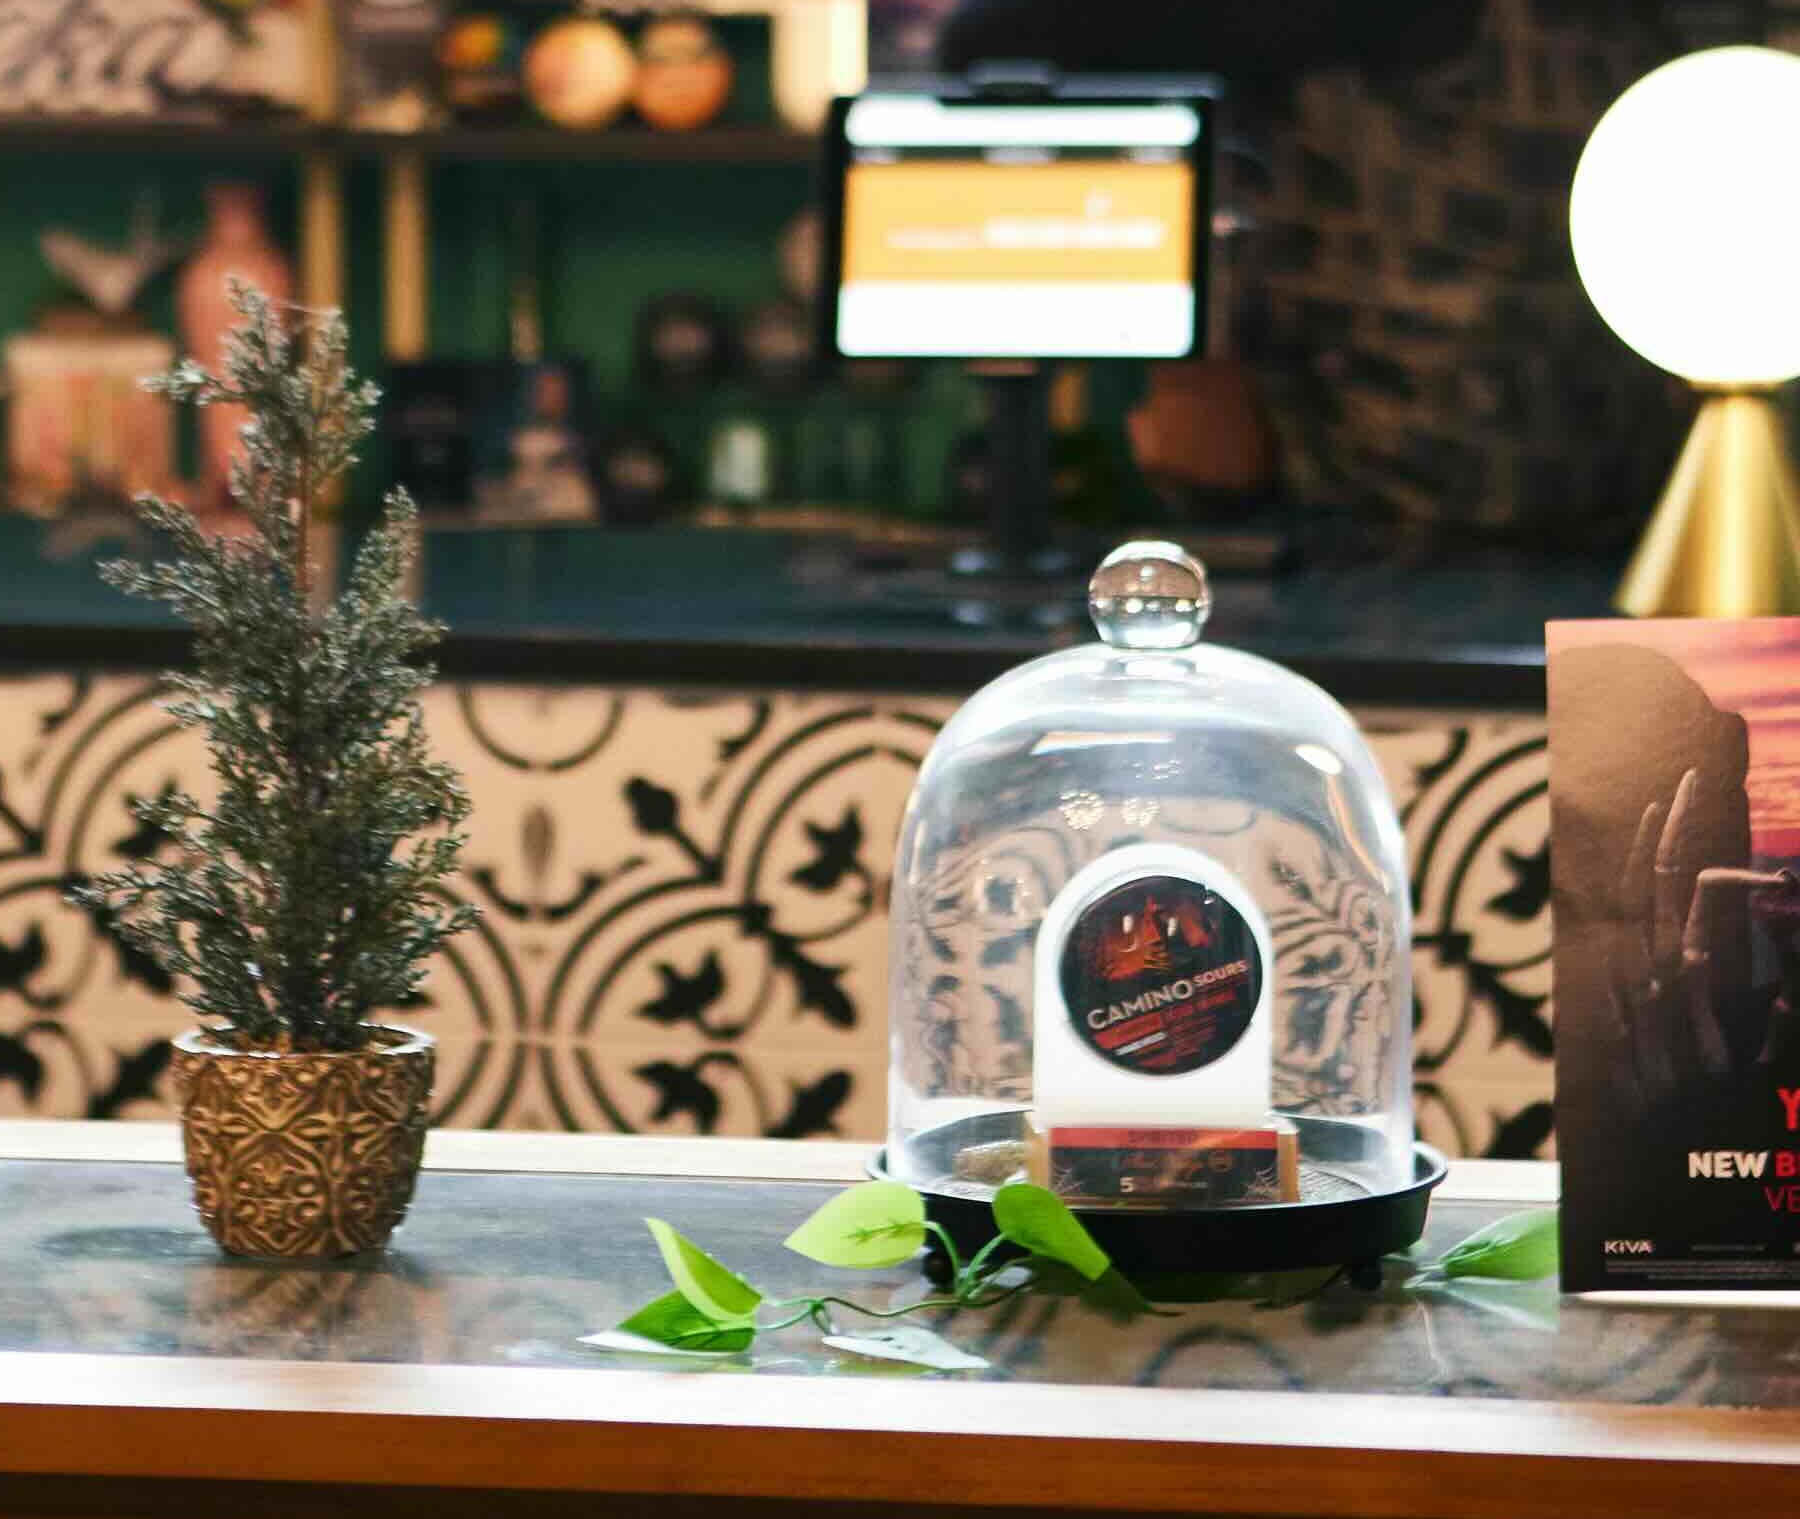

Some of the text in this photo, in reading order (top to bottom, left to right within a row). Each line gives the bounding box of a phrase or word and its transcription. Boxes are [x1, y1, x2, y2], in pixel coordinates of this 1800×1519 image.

[1087, 979, 1193, 1030] CAMINO
[1192, 960, 1249, 987] SOURS
[1687, 1151, 1770, 1179] NEW
